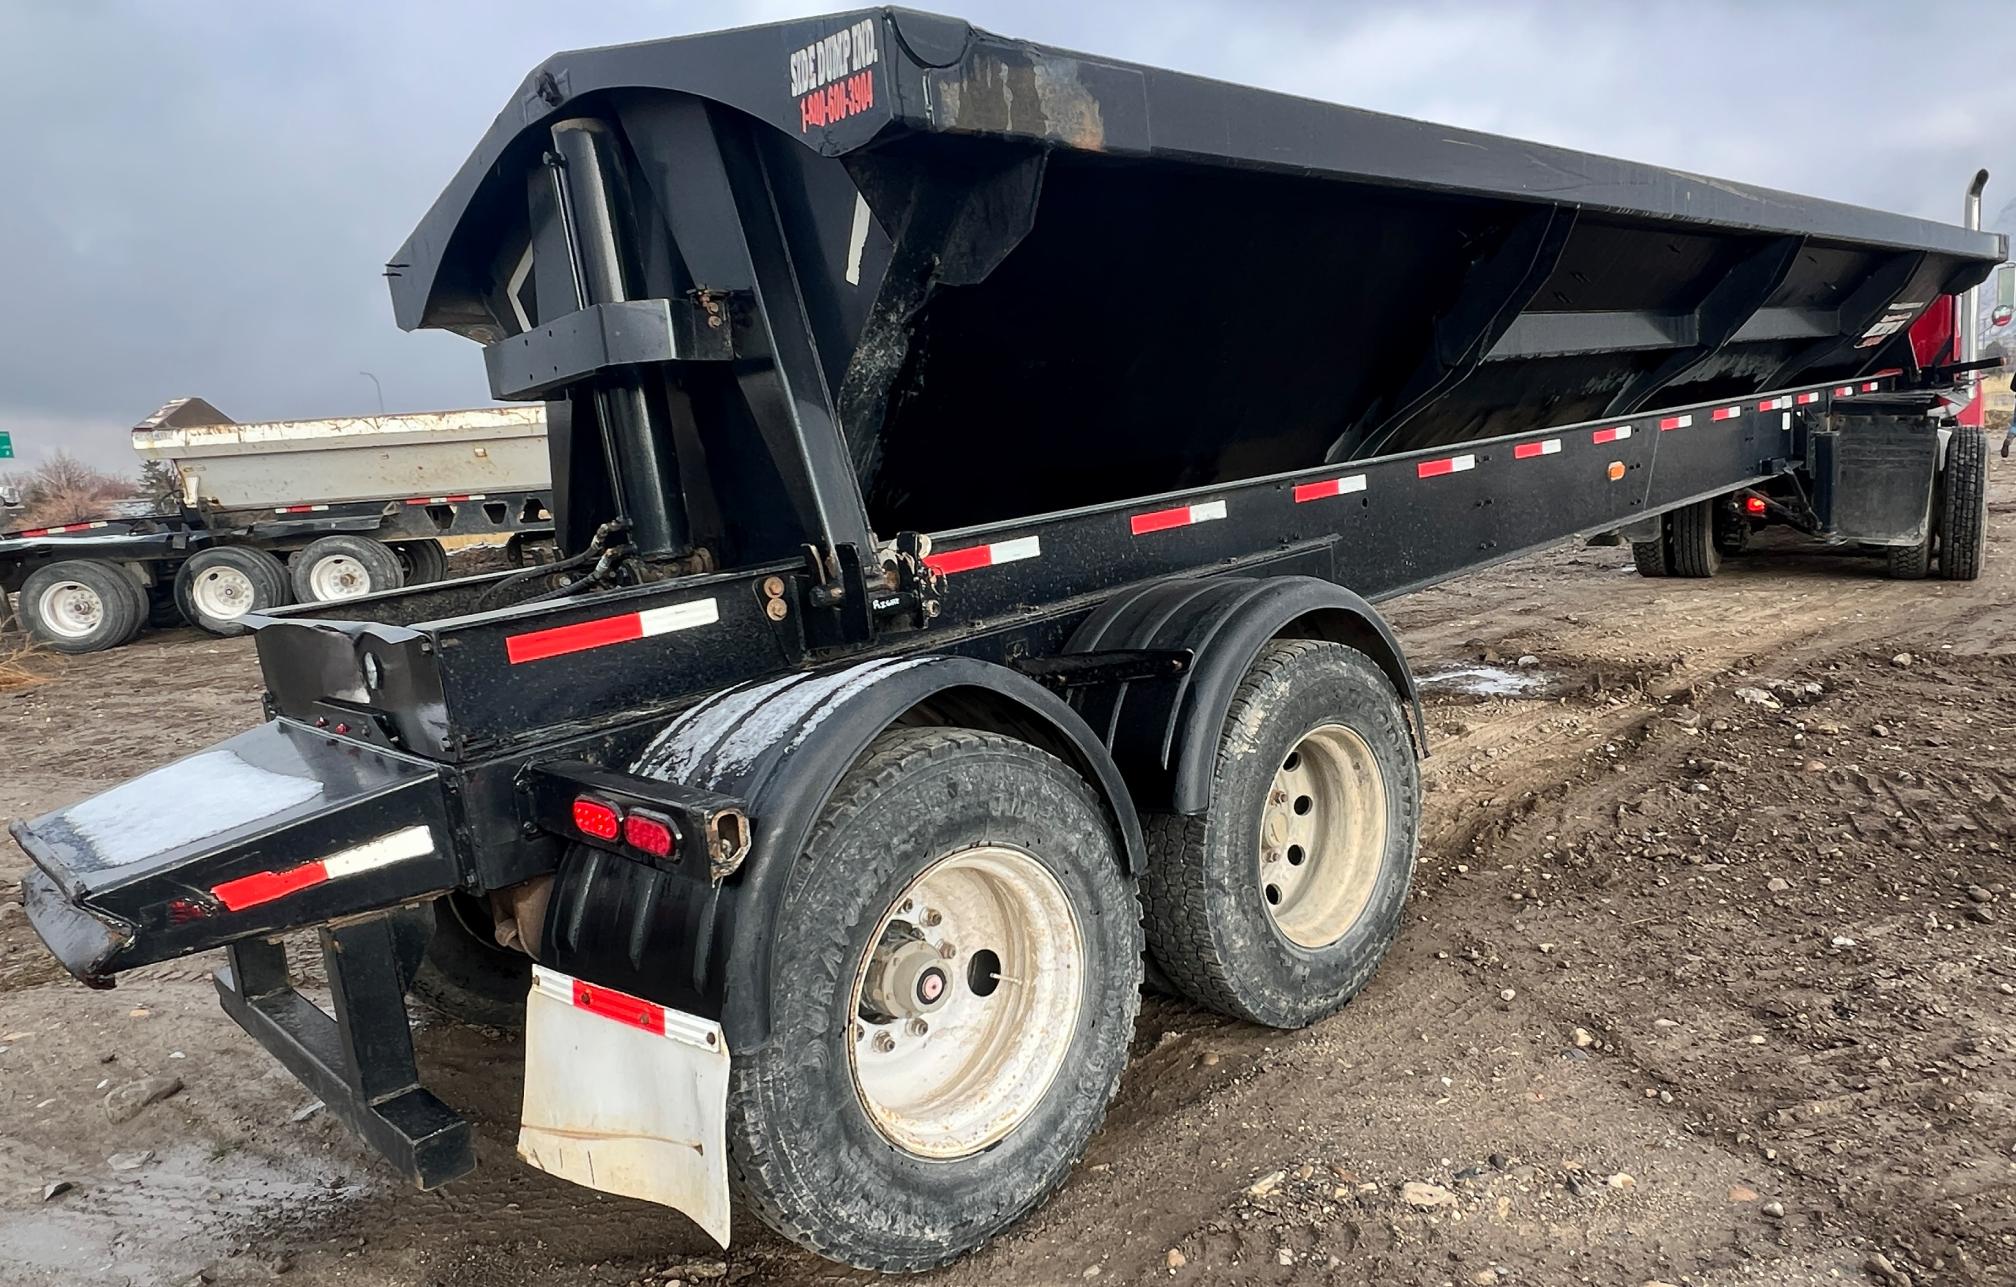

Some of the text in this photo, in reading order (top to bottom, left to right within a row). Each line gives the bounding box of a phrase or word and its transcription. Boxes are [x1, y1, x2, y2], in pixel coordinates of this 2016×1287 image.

[790, 18, 879, 98] SIDE DUMP IND.
